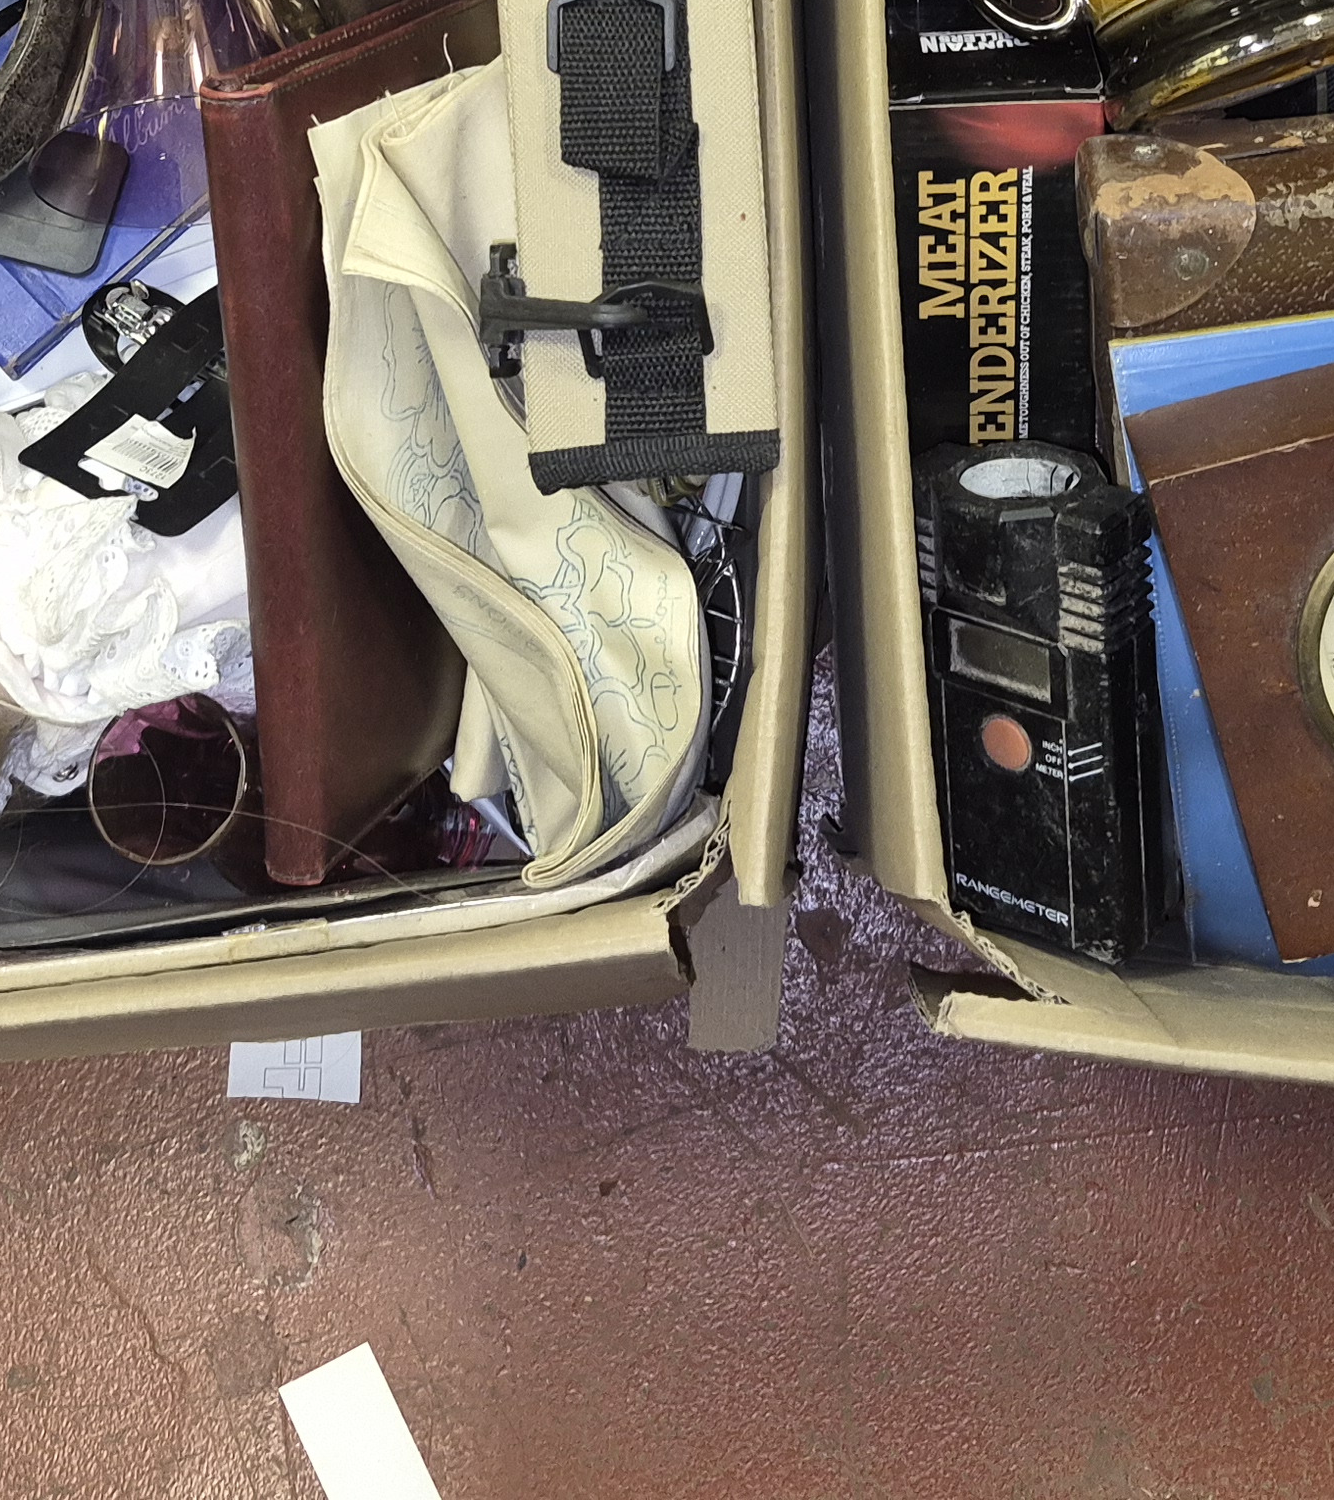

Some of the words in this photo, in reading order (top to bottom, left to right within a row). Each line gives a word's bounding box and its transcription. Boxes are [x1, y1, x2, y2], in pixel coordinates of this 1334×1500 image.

[1022, 165, 1033, 194] VEAL
[1021, 202, 1032, 232] PORK
[917, 170, 966, 319] MEAT
[1021, 233, 1033, 271] STEAK,
[968, 167, 1018, 445] ENDERIZER
[1020, 272, 1032, 323] CHICKEN,
[1020, 323, 1030, 338] OF
[1019, 339, 1030, 360] OUT
[1019, 361, 1030, 422] TOUGHNESS
[1041, 739, 1063, 755] INCH
[1044, 752, 1062, 765] OFF
[1035, 762, 1064, 780] METER
[955, 871, 1069, 927] RANGEMETER
